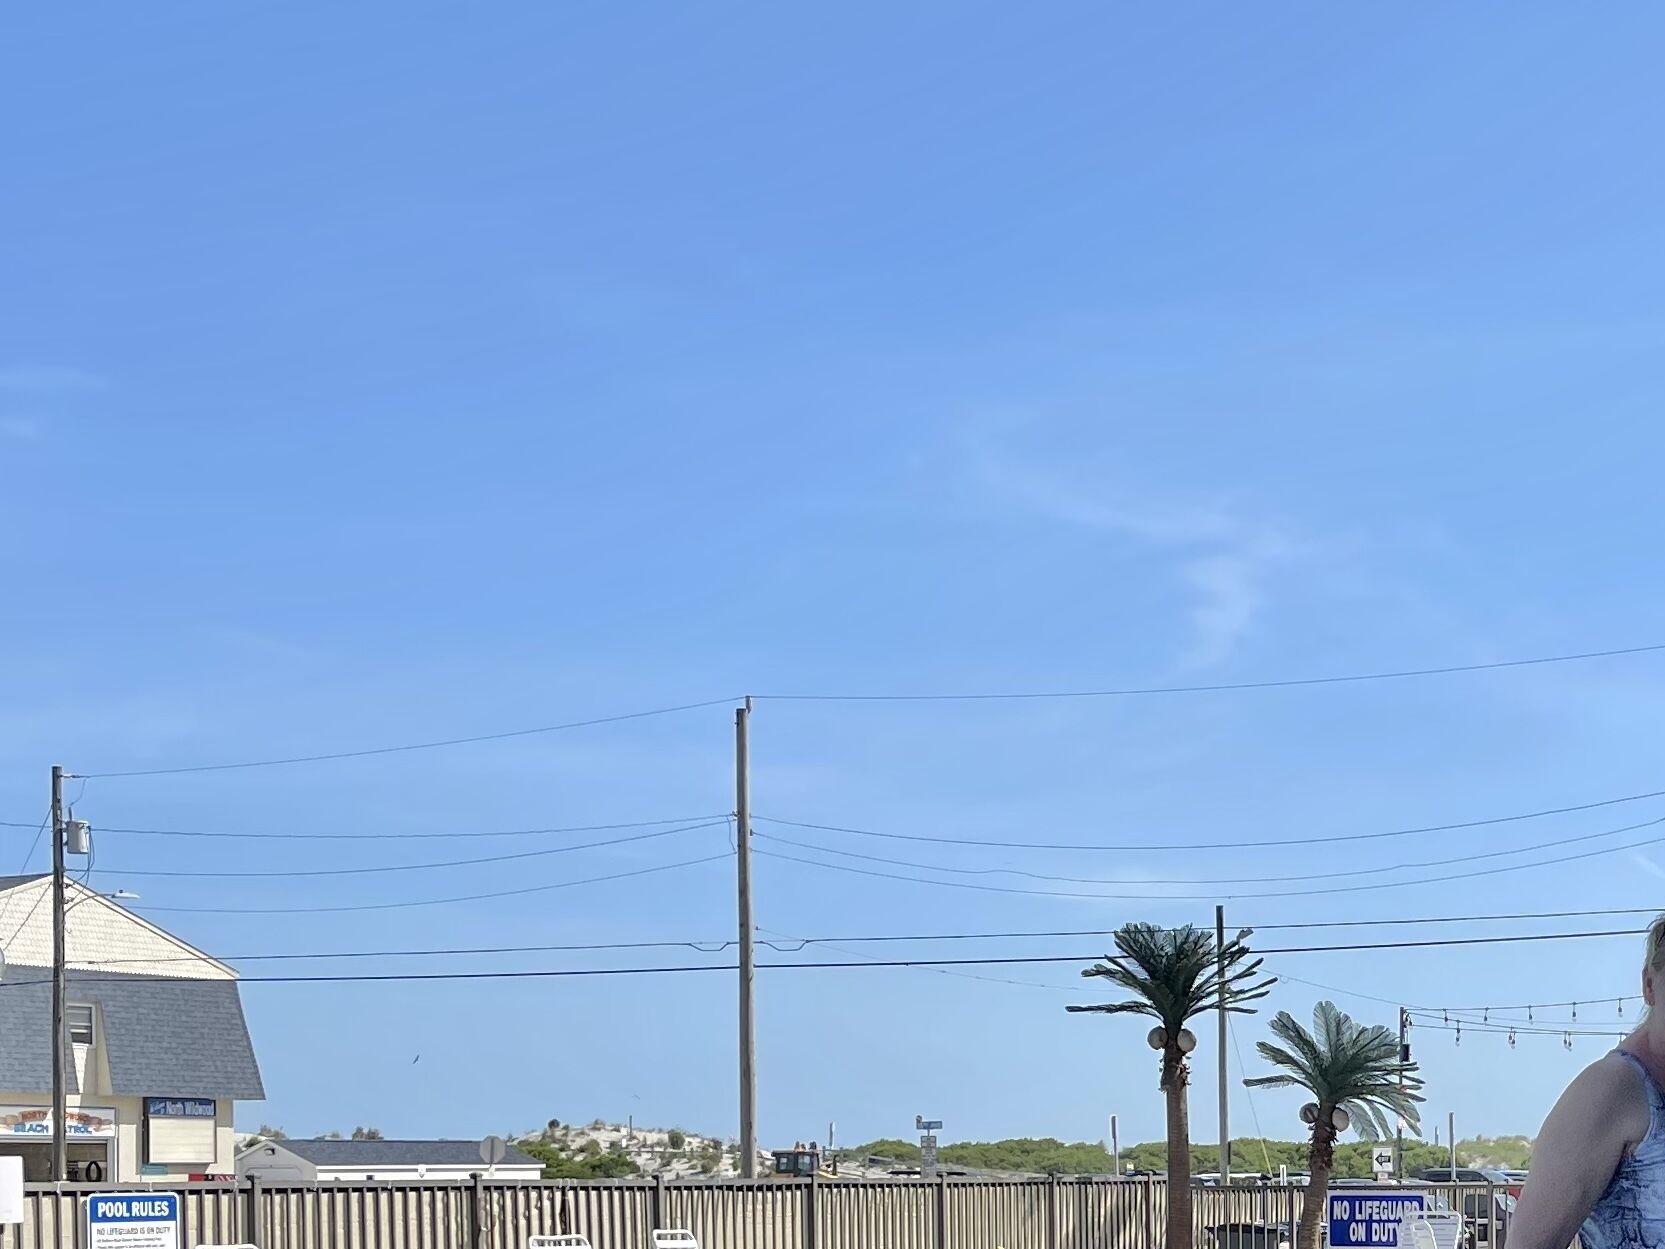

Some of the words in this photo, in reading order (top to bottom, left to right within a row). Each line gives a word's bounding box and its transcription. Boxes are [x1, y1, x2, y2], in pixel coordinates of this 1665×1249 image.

[14, 1123, 49, 1134] BEACH
[97, 1201, 130, 1218] POOL
[131, 1200, 170, 1217] RULES
[1333, 1200, 1350, 1220] NO
[1355, 1200, 1420, 1220] LIFEGUARD
[1349, 1221, 1366, 1242] ON
